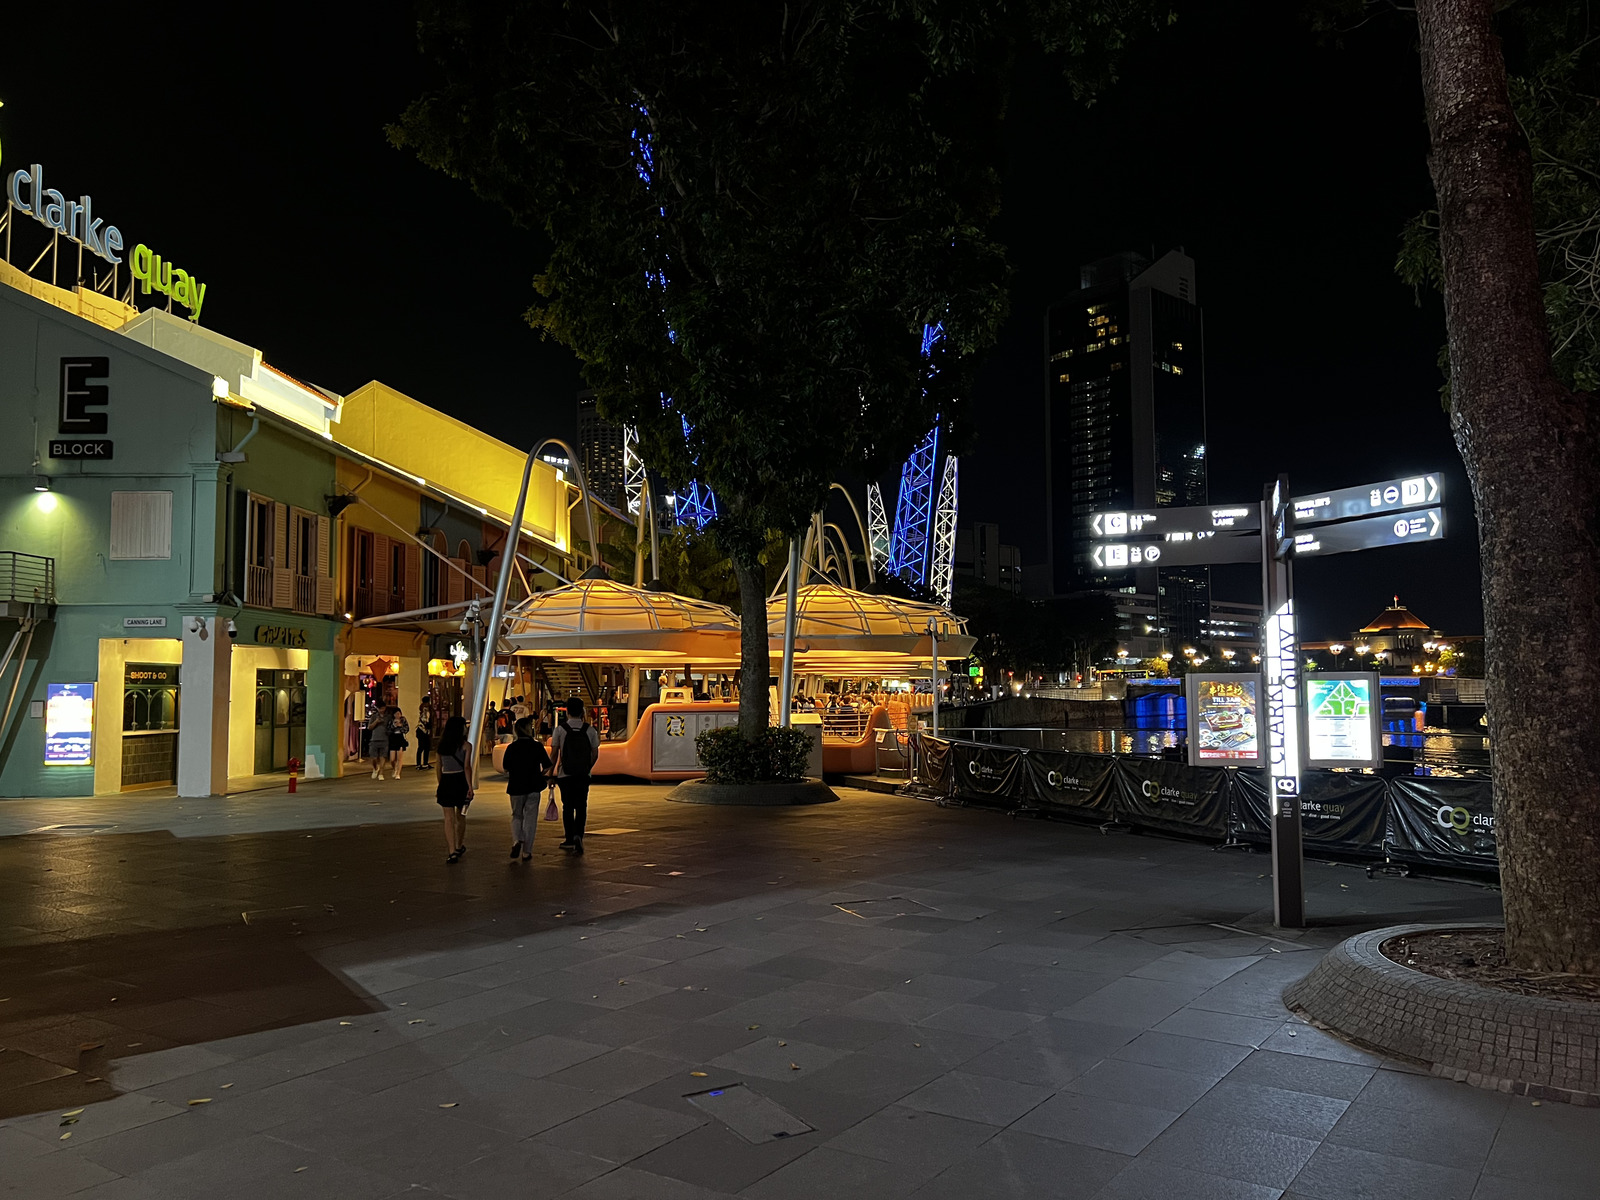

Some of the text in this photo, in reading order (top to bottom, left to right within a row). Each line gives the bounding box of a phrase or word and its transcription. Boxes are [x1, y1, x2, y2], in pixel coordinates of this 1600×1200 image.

[7, 164, 206, 320] clarke quay
[58, 356, 109, 434] E
[53, 443, 104, 455] BLOCK
[1409, 484, 1418, 496] D
[1111, 516, 1121, 528] C
[1280, 628, 1297, 690] QUAY
[130, 671, 152, 680] SHOOT
[158, 672, 167, 680] GO
[1268, 675, 1285, 764] CLARKE
[1063, 775, 1079, 786] clarke
[1160, 786, 1180, 798] clarke
[1299, 800, 1345, 815] larke quay
[1473, 813, 1494, 826] clar
